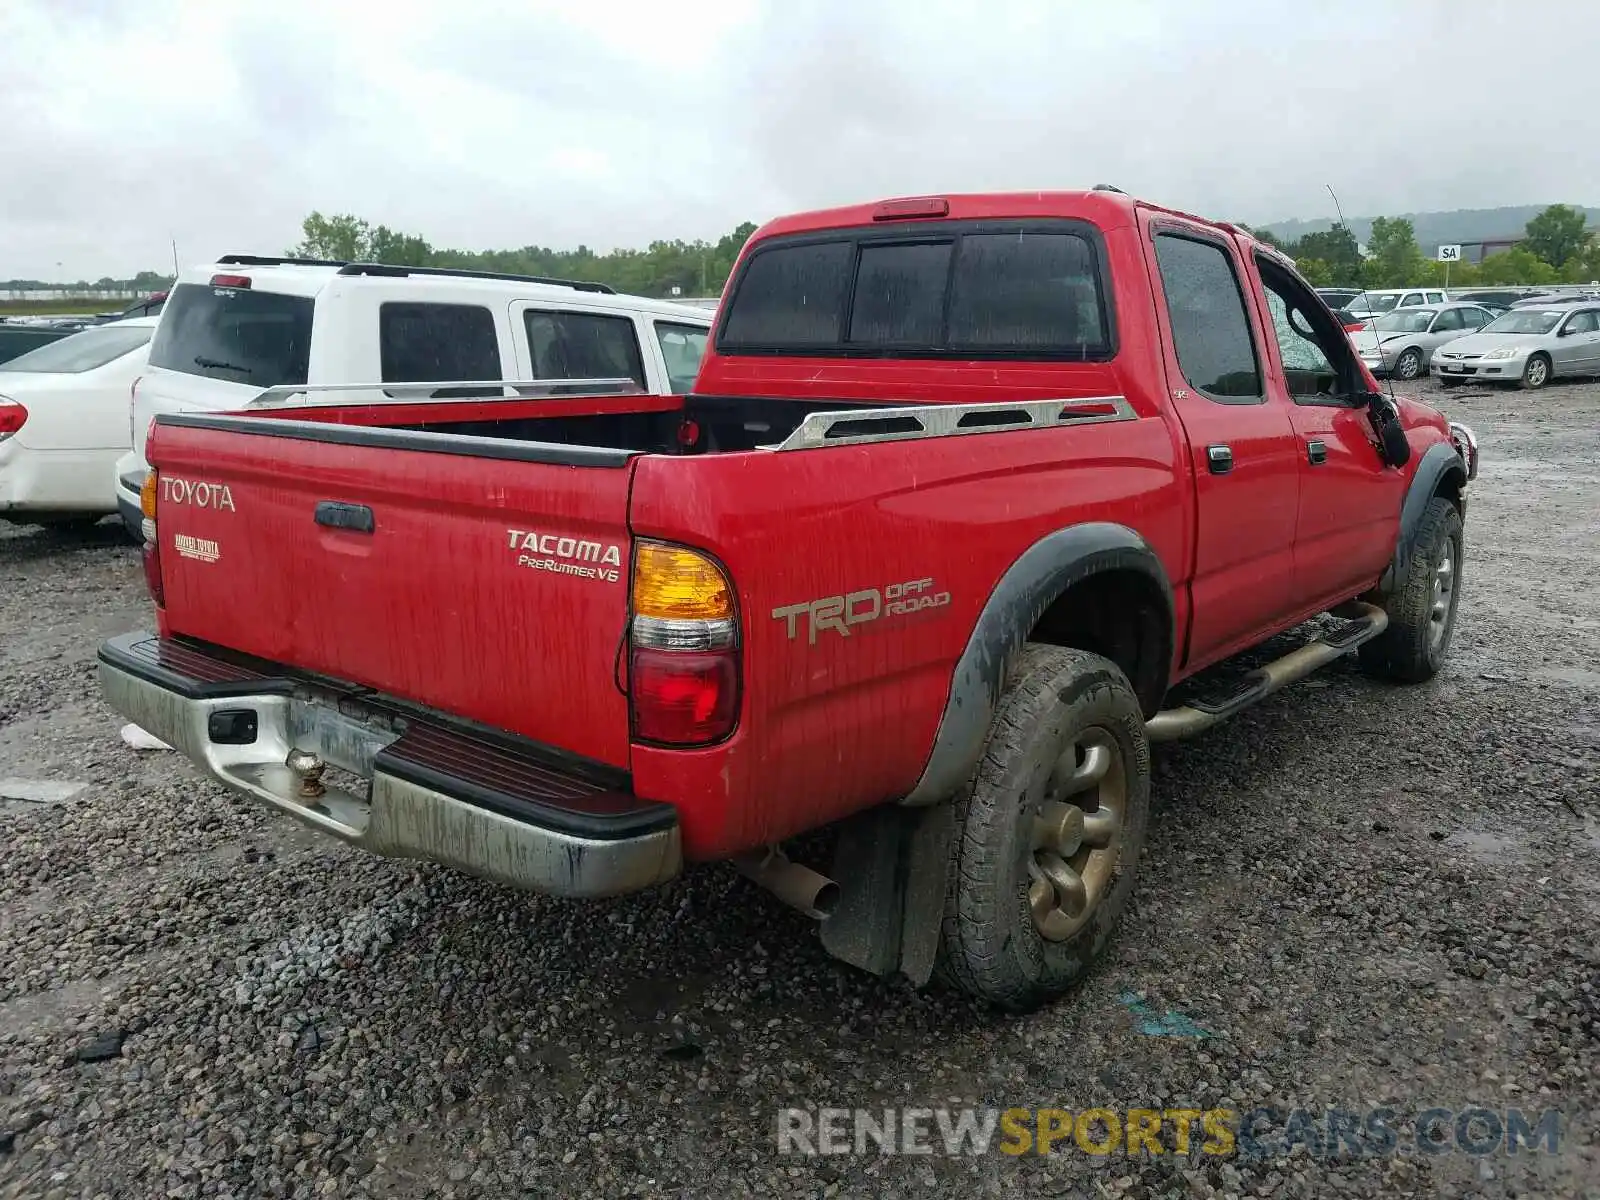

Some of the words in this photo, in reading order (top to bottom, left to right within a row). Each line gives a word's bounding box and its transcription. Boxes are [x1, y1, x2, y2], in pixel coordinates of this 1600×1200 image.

[1442, 247, 1456, 259] SA
[160, 476, 236, 513] TOYOTA
[507, 529, 621, 567] TACOMA
[596, 567, 620, 583] V6
[885, 577, 933, 599] OFF
[771, 588, 882, 645] TRD
[885, 591, 951, 617] ROAD
